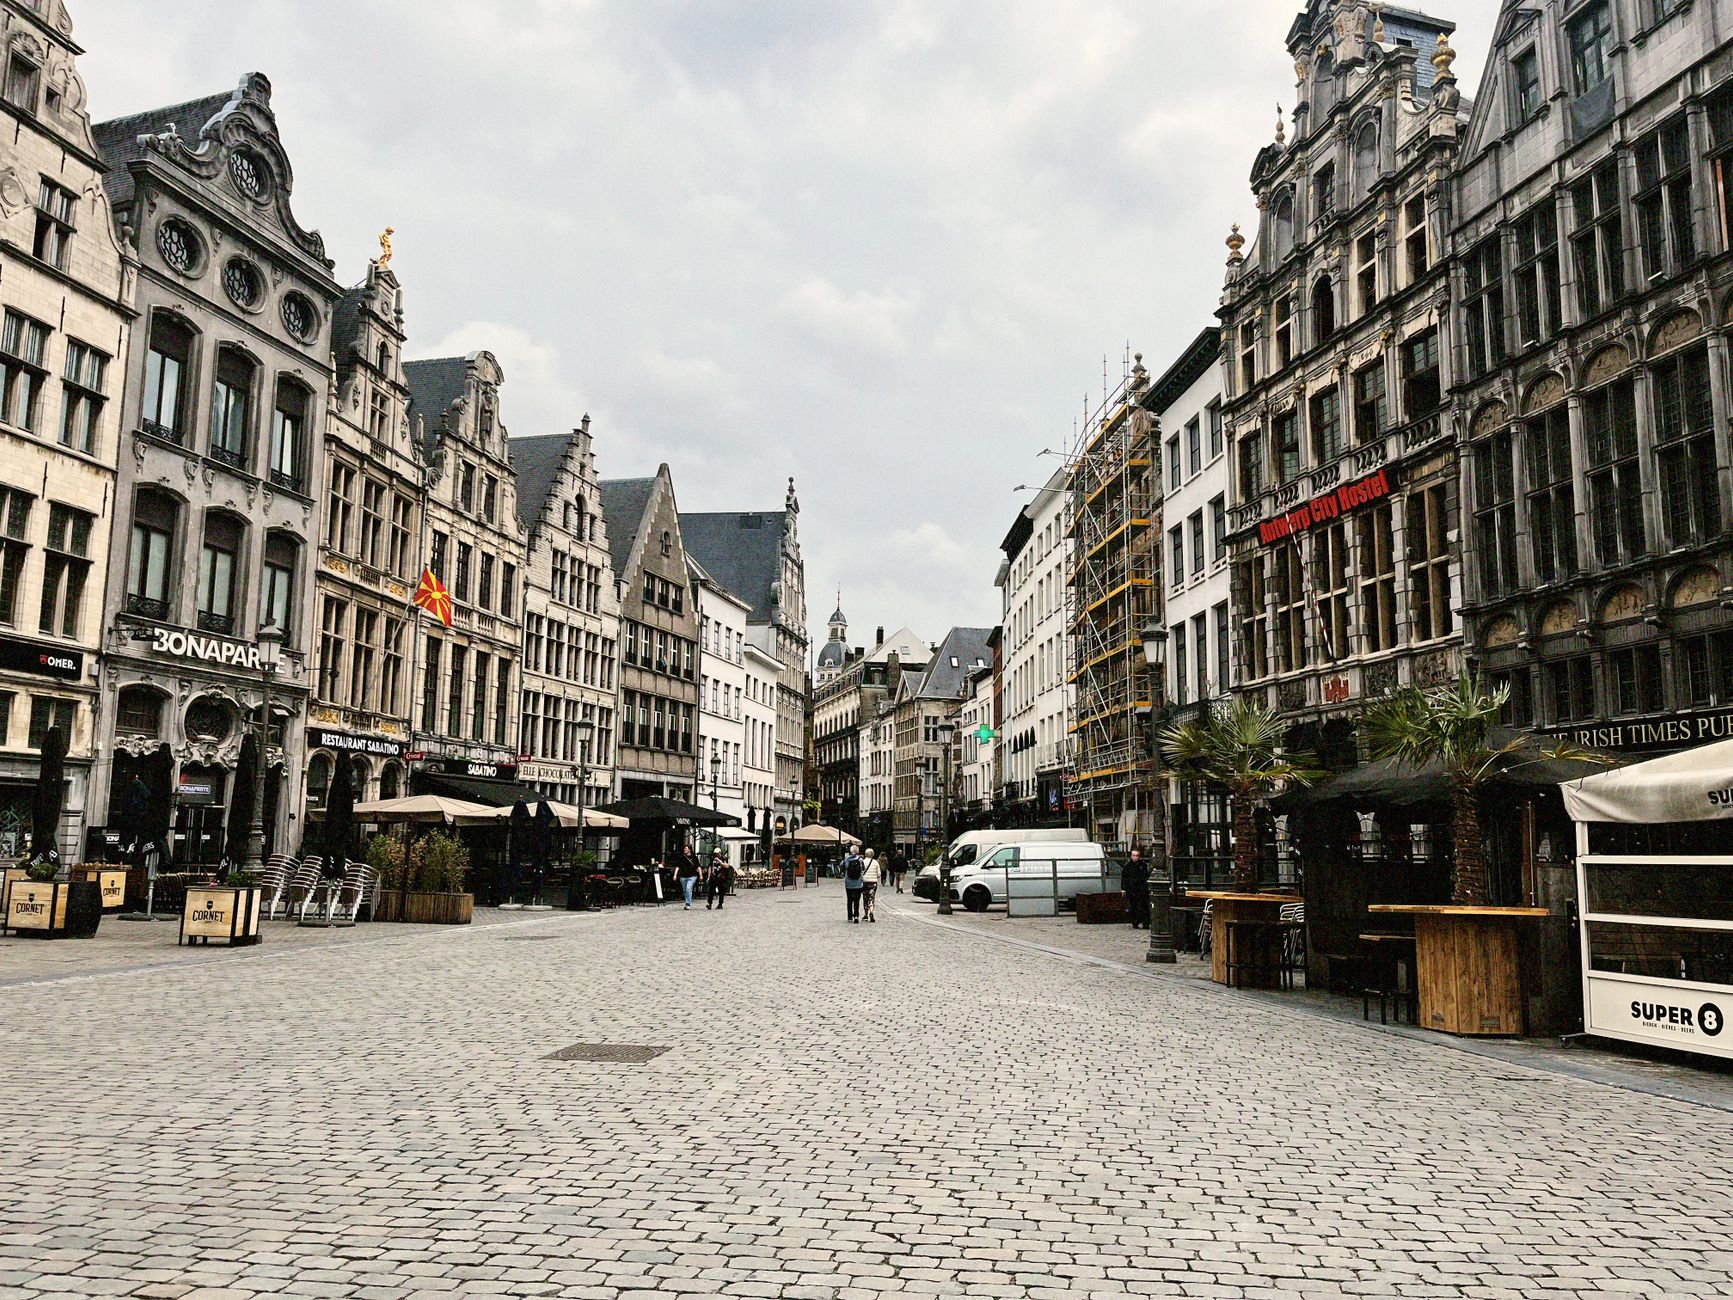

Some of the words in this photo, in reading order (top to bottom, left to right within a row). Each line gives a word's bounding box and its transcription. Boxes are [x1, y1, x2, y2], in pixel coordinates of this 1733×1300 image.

[1260, 505, 1311, 544] Antwerp
[1309, 495, 1339, 522] City
[1337, 469, 1390, 511] Hostel
[152, 627, 286, 674] BONAPARE
[1627, 719, 1691, 744] TIMES
[321, 733, 367, 751] RESTAURANT
[367, 740, 400, 755] SABATINO
[467, 763, 497, 777] SABATINO
[1707, 789, 1733, 805] SU
[103, 887, 120, 897] CORNET
[15, 902, 45, 915] CORNET
[192, 909, 225, 923] CORNET
[1631, 1000, 1694, 1027] SUPER
